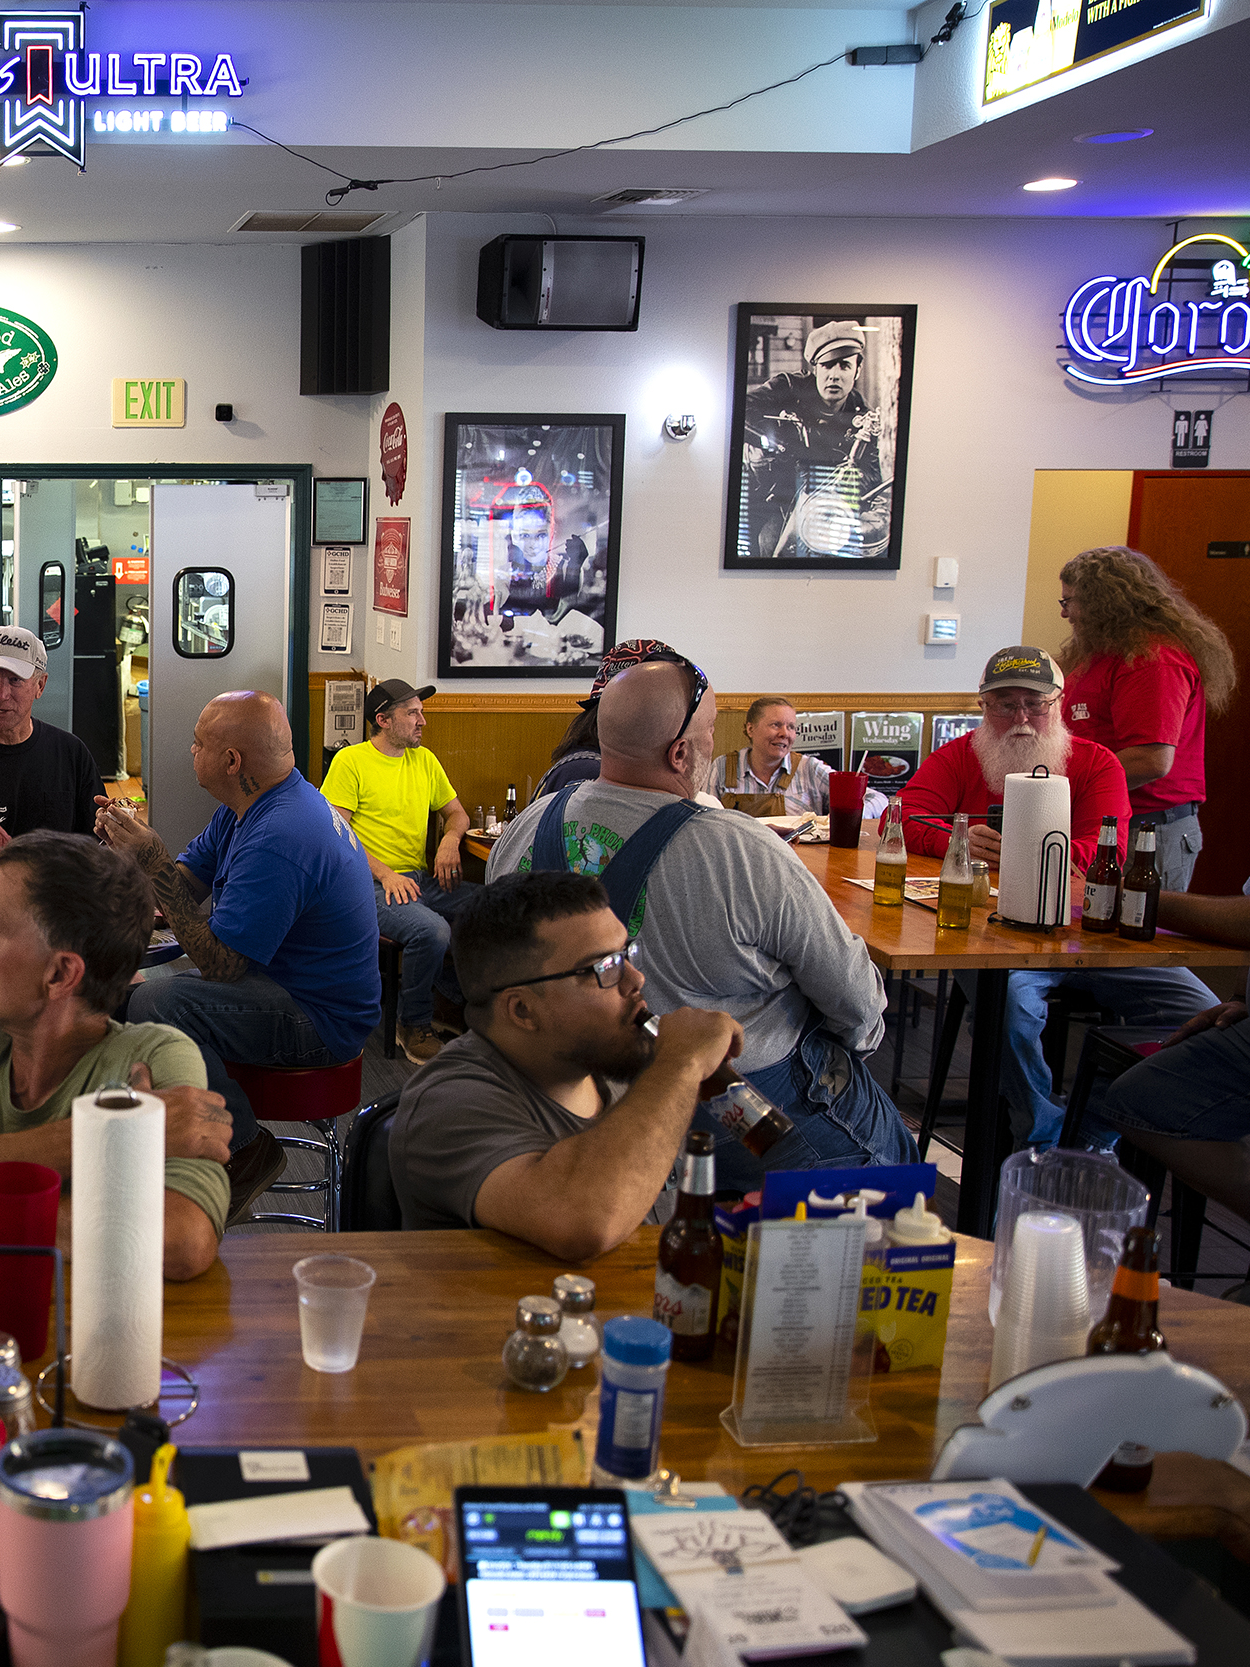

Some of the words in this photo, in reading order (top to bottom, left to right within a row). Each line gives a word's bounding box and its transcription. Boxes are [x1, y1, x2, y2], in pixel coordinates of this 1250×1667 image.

[1087, 4, 1111, 25] WITH
[64, 52, 244, 97] ULTRA
[94, 110, 164, 132] LIGHT
[170, 110, 230, 132] BEER
[125, 381, 176, 420] EXIT
[801, 732, 837, 743] Tuesday
[863, 719, 912, 741] Wing
[862, 737, 899, 746] Wednesday
[895, 1286, 939, 1317] TEA
